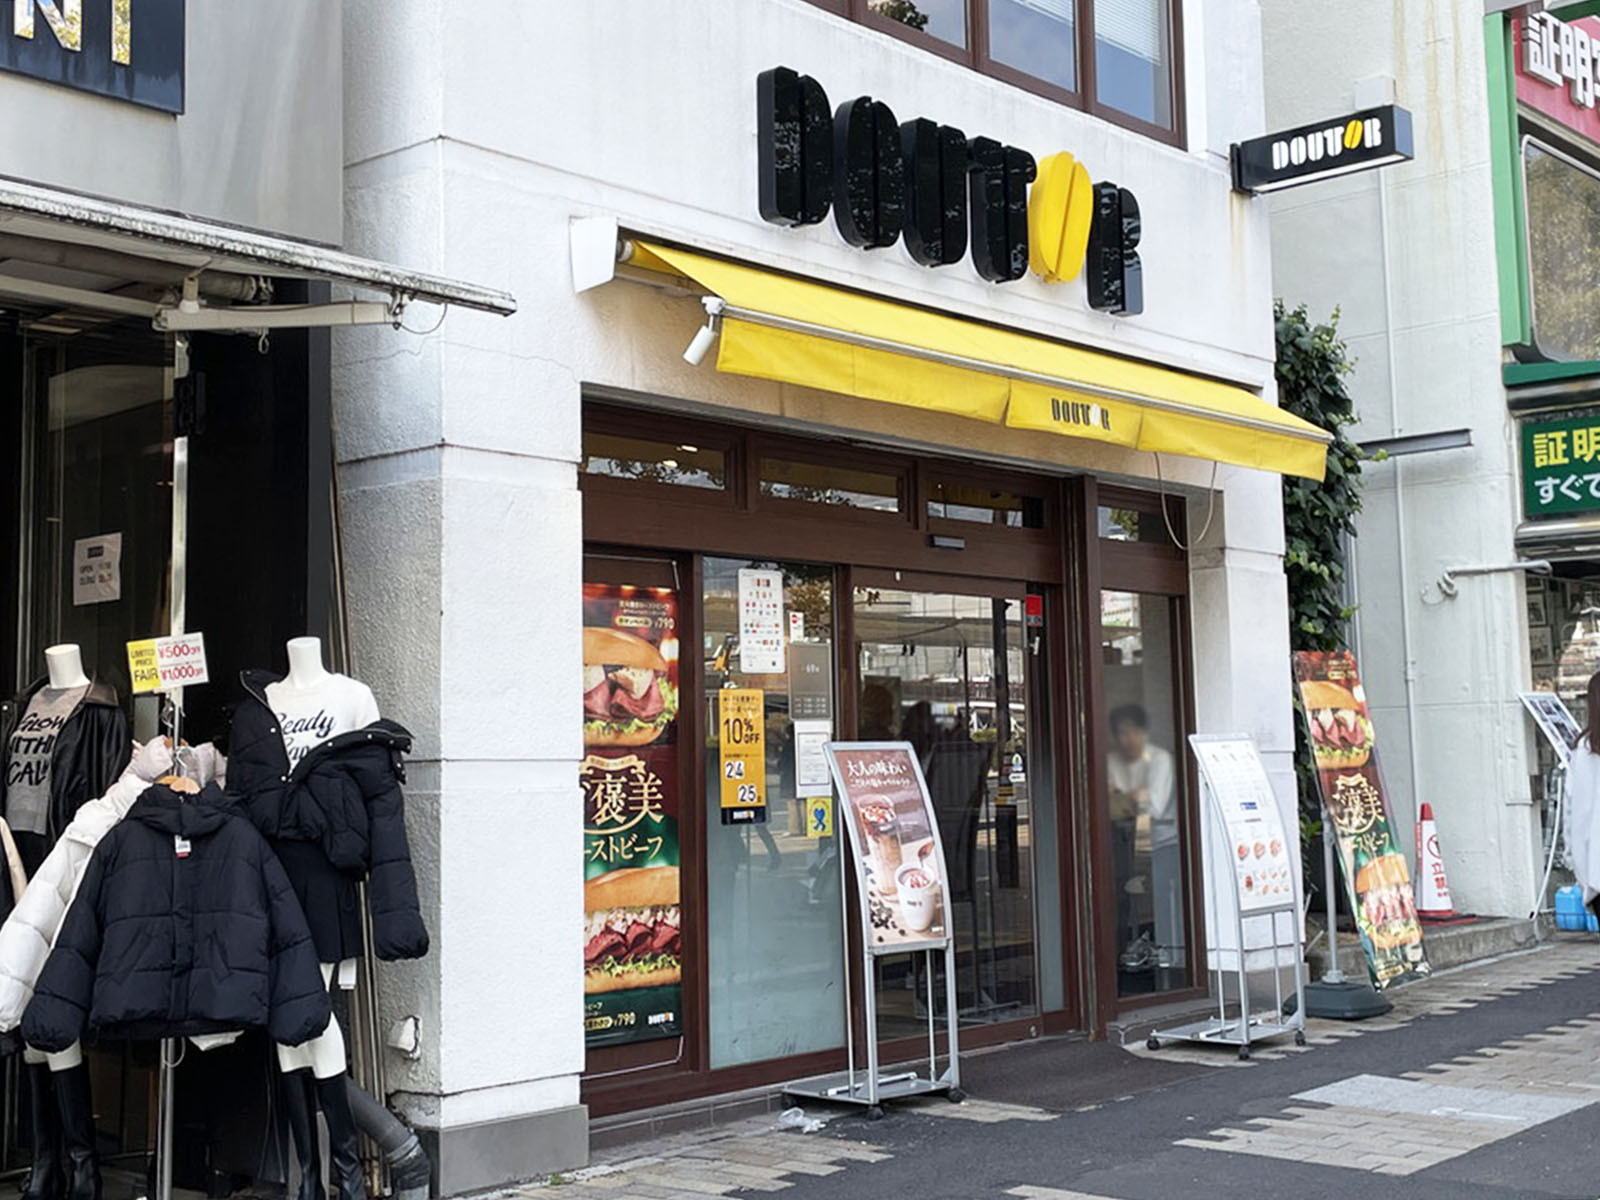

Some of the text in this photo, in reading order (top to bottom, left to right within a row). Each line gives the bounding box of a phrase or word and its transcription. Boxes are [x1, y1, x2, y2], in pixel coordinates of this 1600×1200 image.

[1522, 11, 1600, 109] 証明
[1271, 117, 1382, 170] DOUTOR
[757, 65, 1143, 317] DOUTOR
[1051, 398, 1111, 431] DOUTOR
[158, 643, 190, 659] ¥500
[134, 667, 159, 683] FAIR
[743, 733, 760, 744] OFF
[726, 761, 743, 779] 24
[583, 772, 665, 827] 褒美
[738, 785, 756, 803] 25
